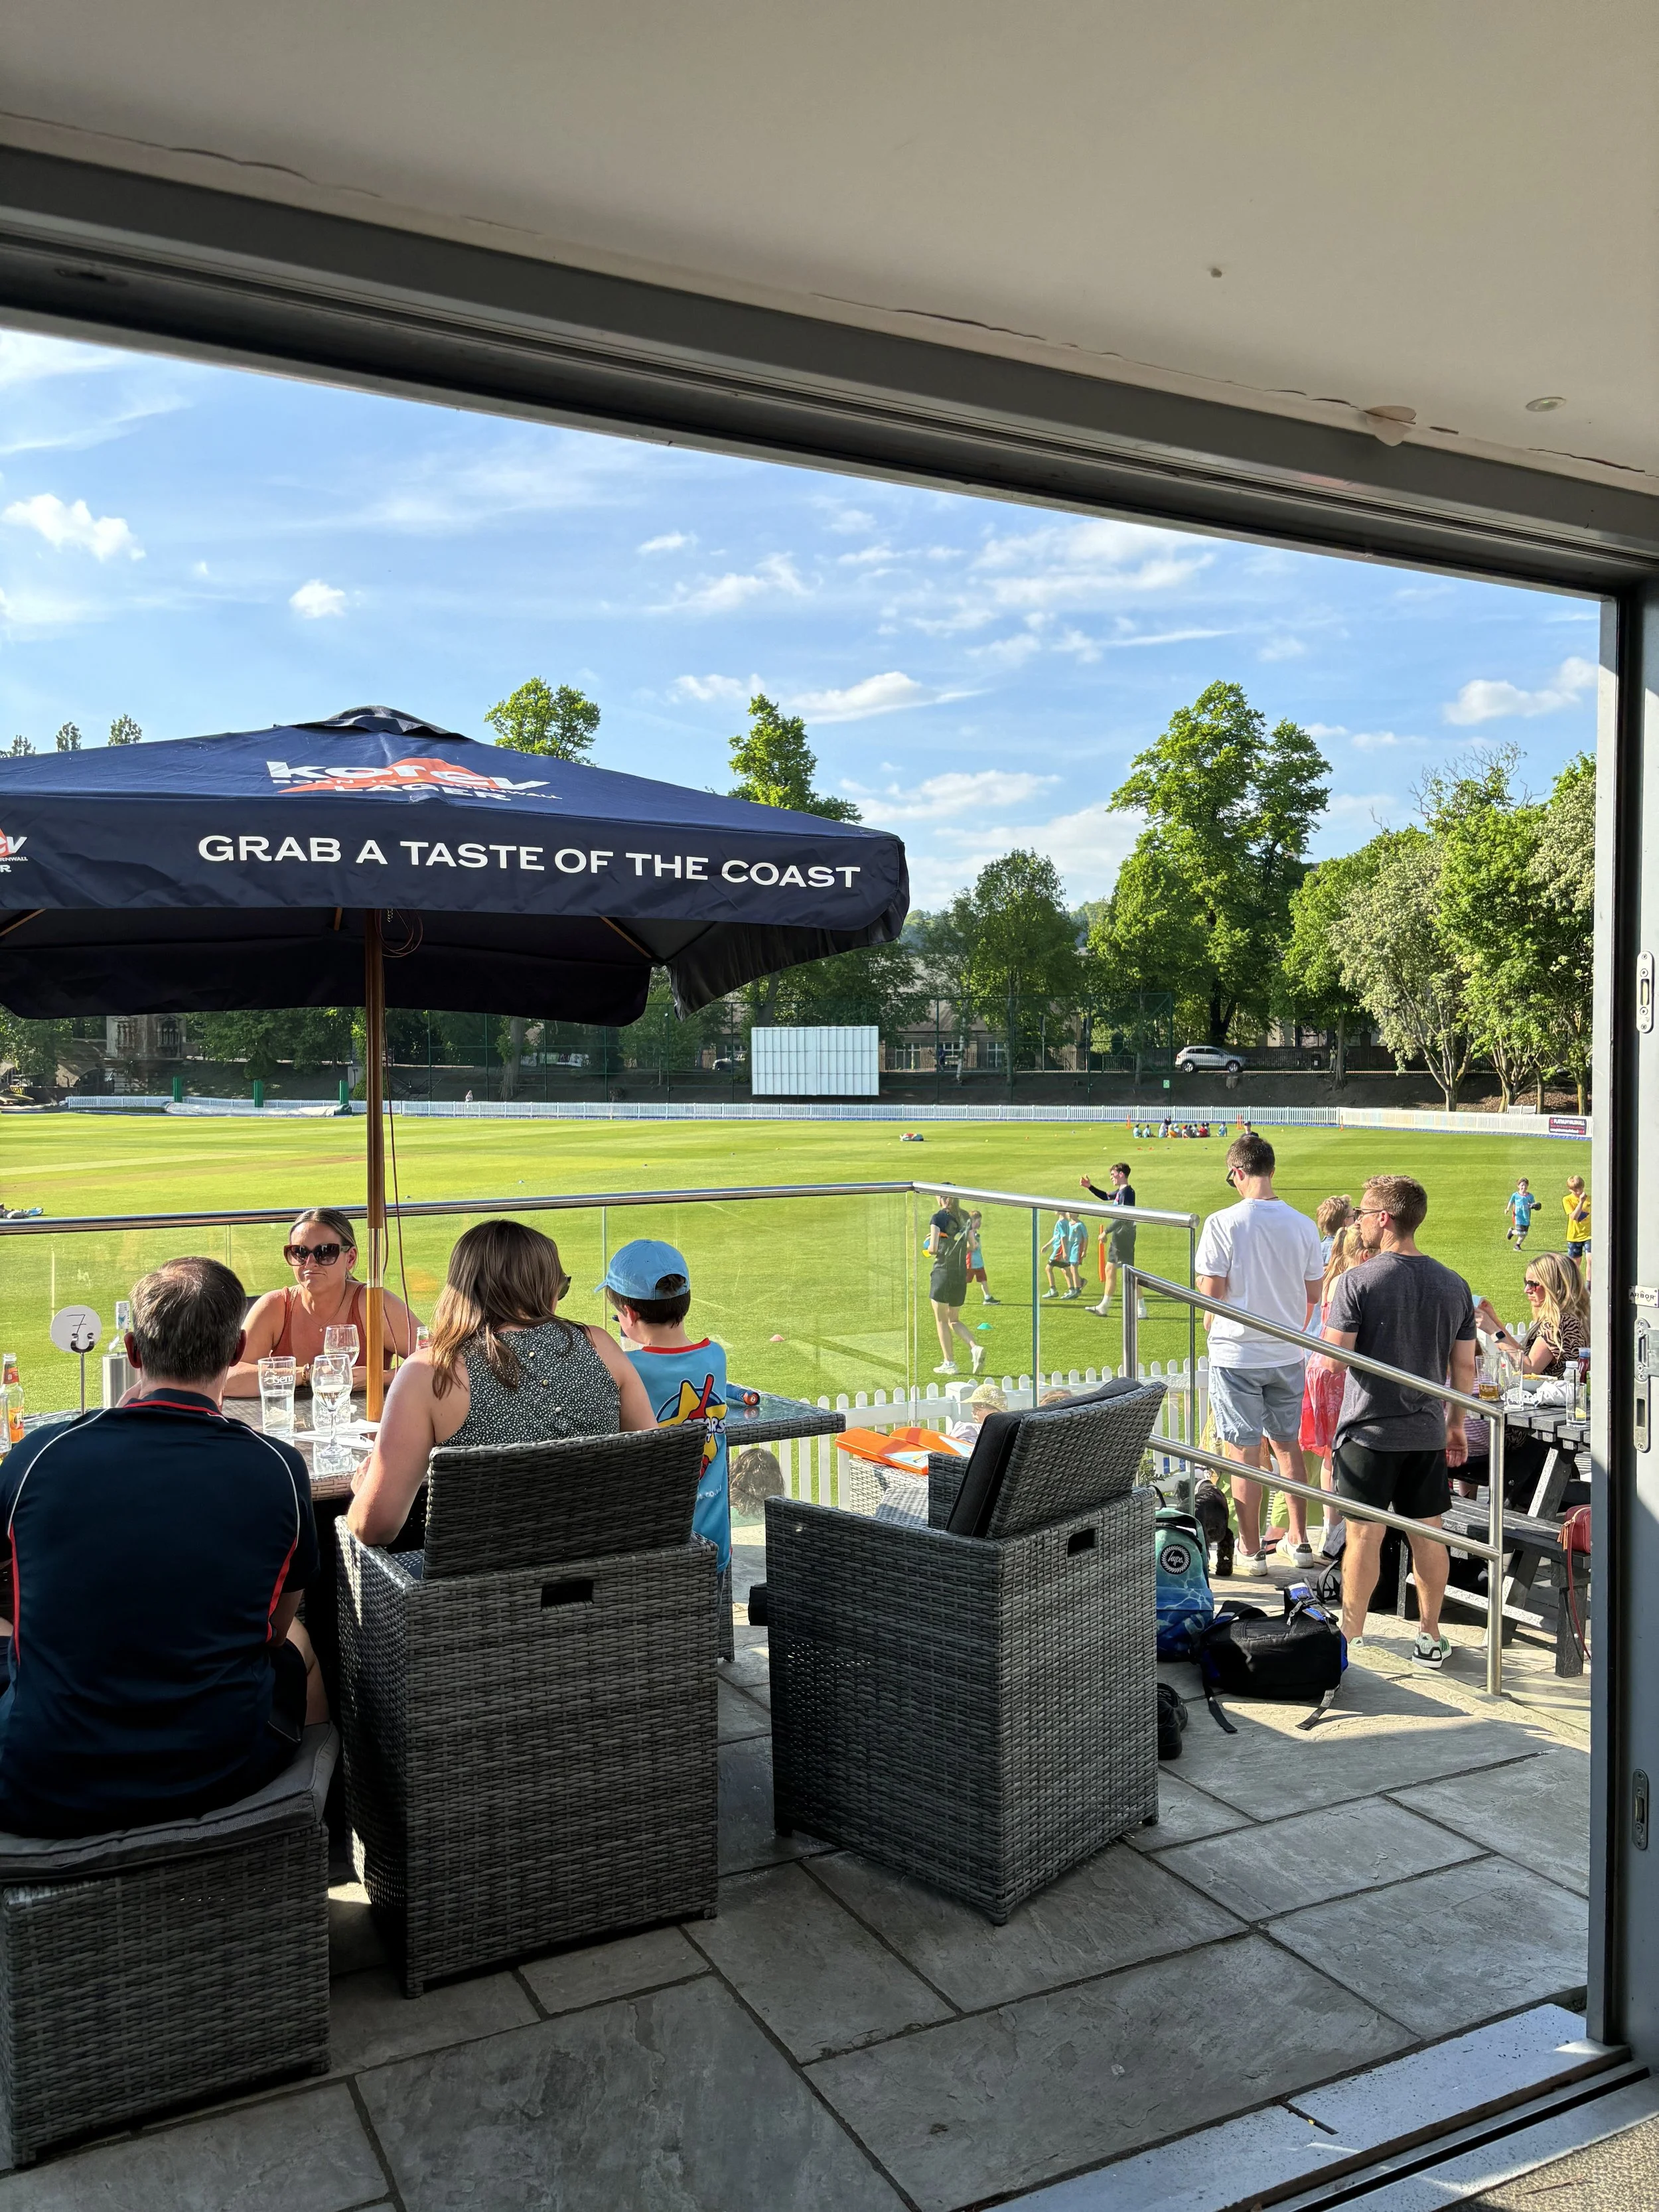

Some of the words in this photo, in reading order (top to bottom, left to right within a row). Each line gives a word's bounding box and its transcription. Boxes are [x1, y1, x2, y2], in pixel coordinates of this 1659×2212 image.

[267, 761, 551, 790] korev
[334, 783, 511, 801] LAGER
[439, 782, 563, 800] CORNWALL
[198, 835, 341, 862] GRAB
[356, 840, 388, 865] A
[399, 840, 545, 871] TASTE
[555, 848, 614, 873] OF
[626, 852, 709, 881] THE
[721, 859, 861, 889] COAST
[66, 1314, 86, 1334] 7
